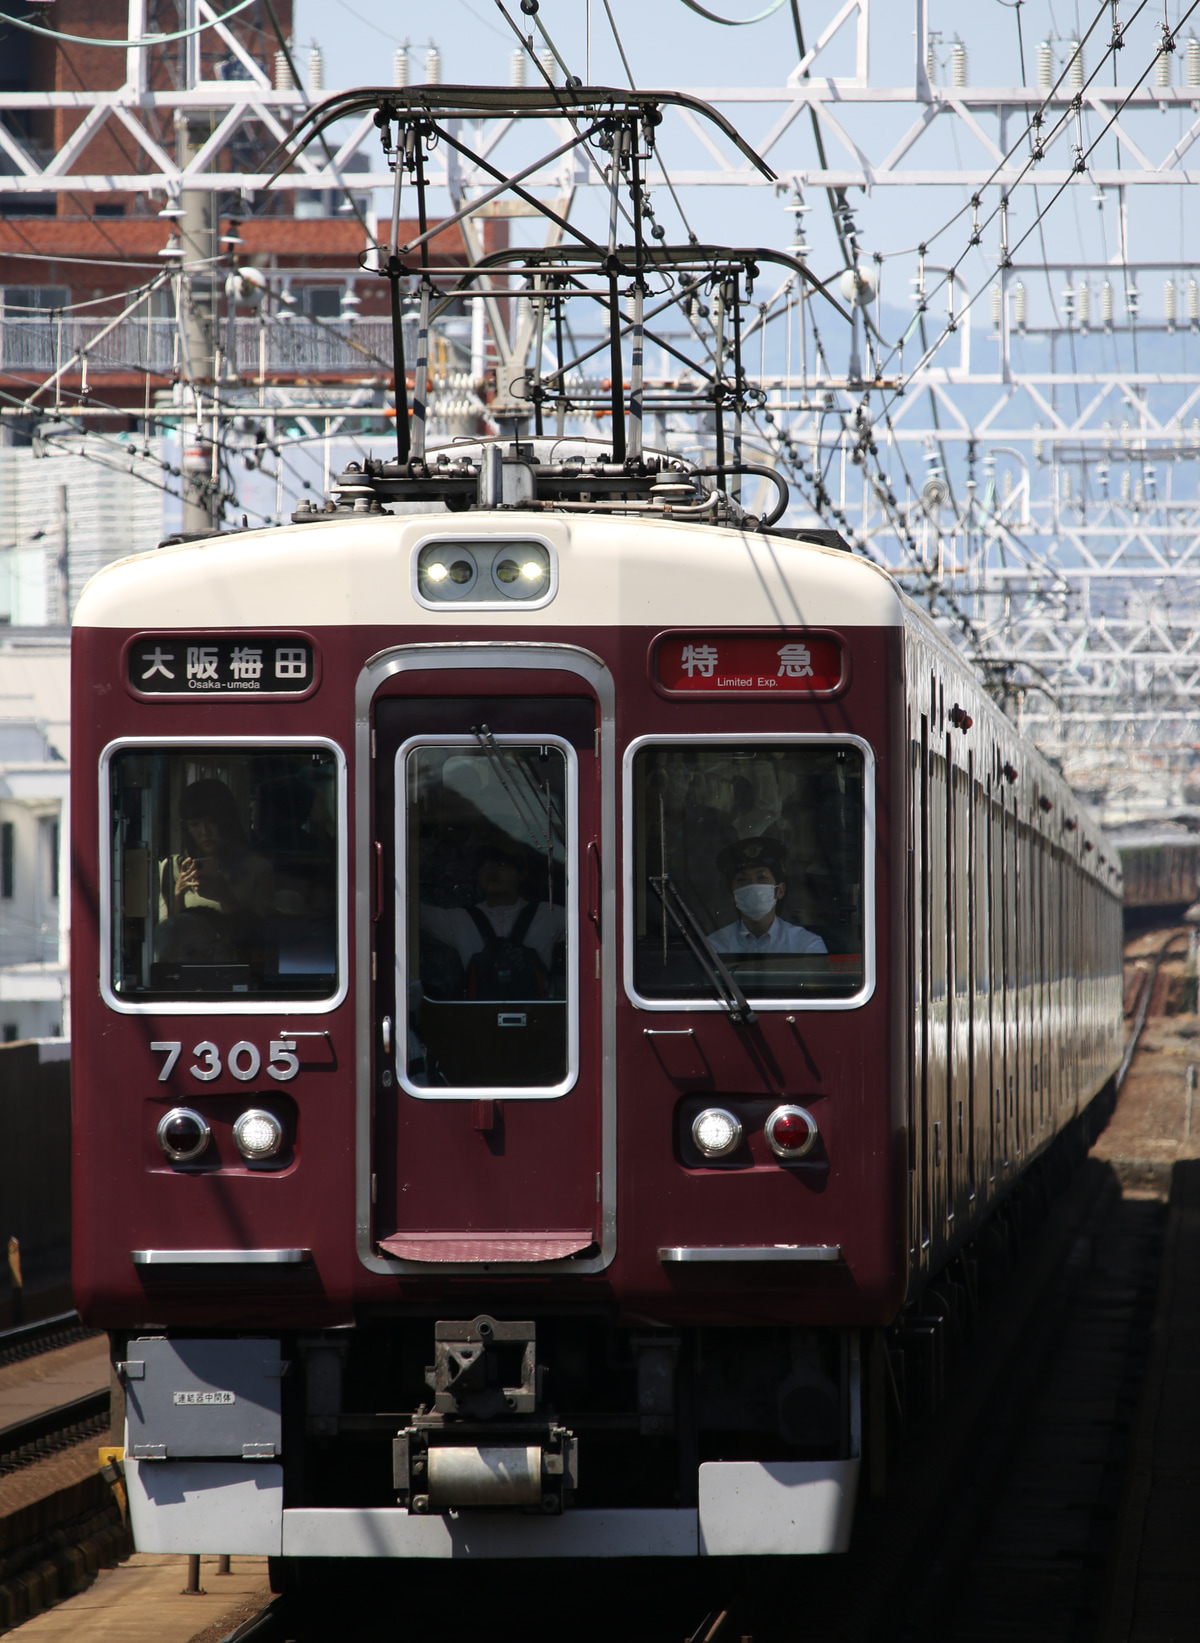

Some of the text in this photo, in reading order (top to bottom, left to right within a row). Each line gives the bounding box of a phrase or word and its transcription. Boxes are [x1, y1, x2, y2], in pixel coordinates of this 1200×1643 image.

[141, 646, 307, 679] 大阪梅田
[681, 644, 814, 677] 特急
[188, 679, 260, 689] Osaka-umeda
[717, 677, 778, 688] Limited Exp.
[150, 1040, 300, 1081] 7305
